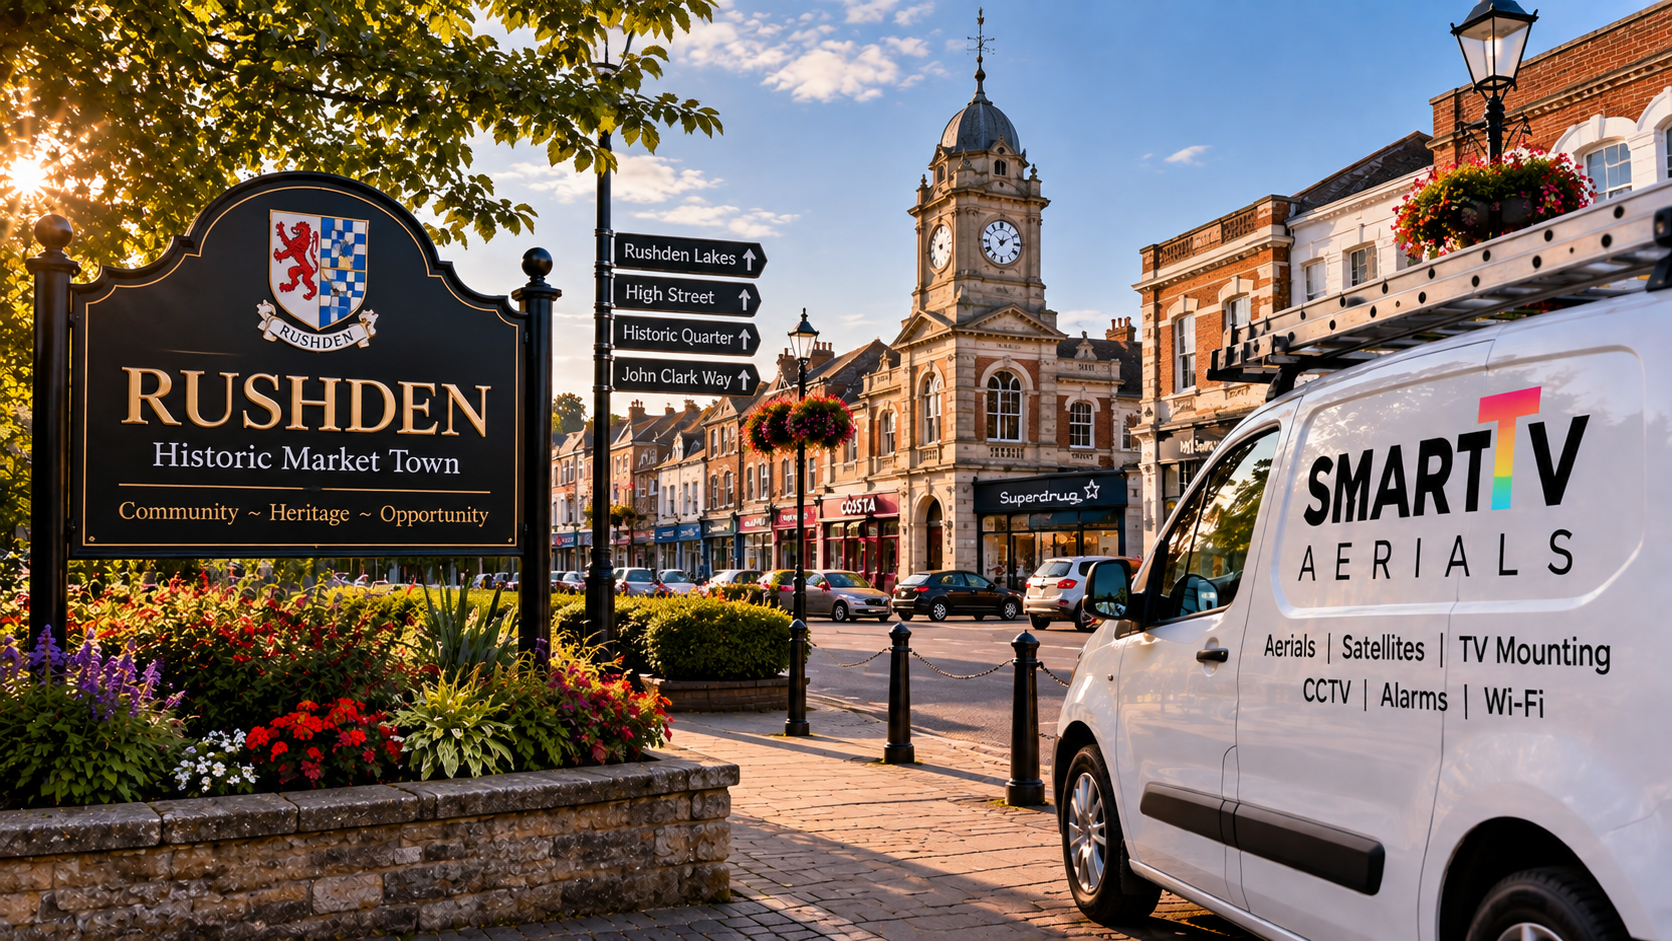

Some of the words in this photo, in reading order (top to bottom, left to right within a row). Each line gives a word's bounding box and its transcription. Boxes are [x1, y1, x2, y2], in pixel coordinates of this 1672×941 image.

[624, 242, 690, 263] Rushden
[694, 248, 737, 266] Lakes
[626, 284, 663, 304] High
[667, 287, 715, 305] Street
[279, 324, 354, 349] RUSHDEN
[623, 324, 678, 343] Historic
[681, 327, 734, 345] Quarter
[621, 366, 657, 383] John
[660, 368, 699, 385] Clark
[701, 370, 733, 390] Way
[121, 366, 492, 438] RUSHDEN
[152, 441, 272, 470] Historic
[281, 445, 381, 472] Market
[388, 448, 461, 475] Town
[1000, 490, 1083, 507] Superdrug
[118, 501, 239, 526] Community
[269, 503, 350, 527] Heritage
[380, 505, 489, 528] Opportunity
[1297, 528, 1573, 582] AERIALS
[1264, 633, 1316, 658] Aerials
[1342, 633, 1425, 662] Satellites
[1458, 635, 1489, 663] TV
[1496, 635, 1612, 676] Mounting
[1303, 677, 1352, 704] CCTV
[1380, 681, 1448, 712] Alarms
[1483, 686, 1545, 719] Wi-Fi
